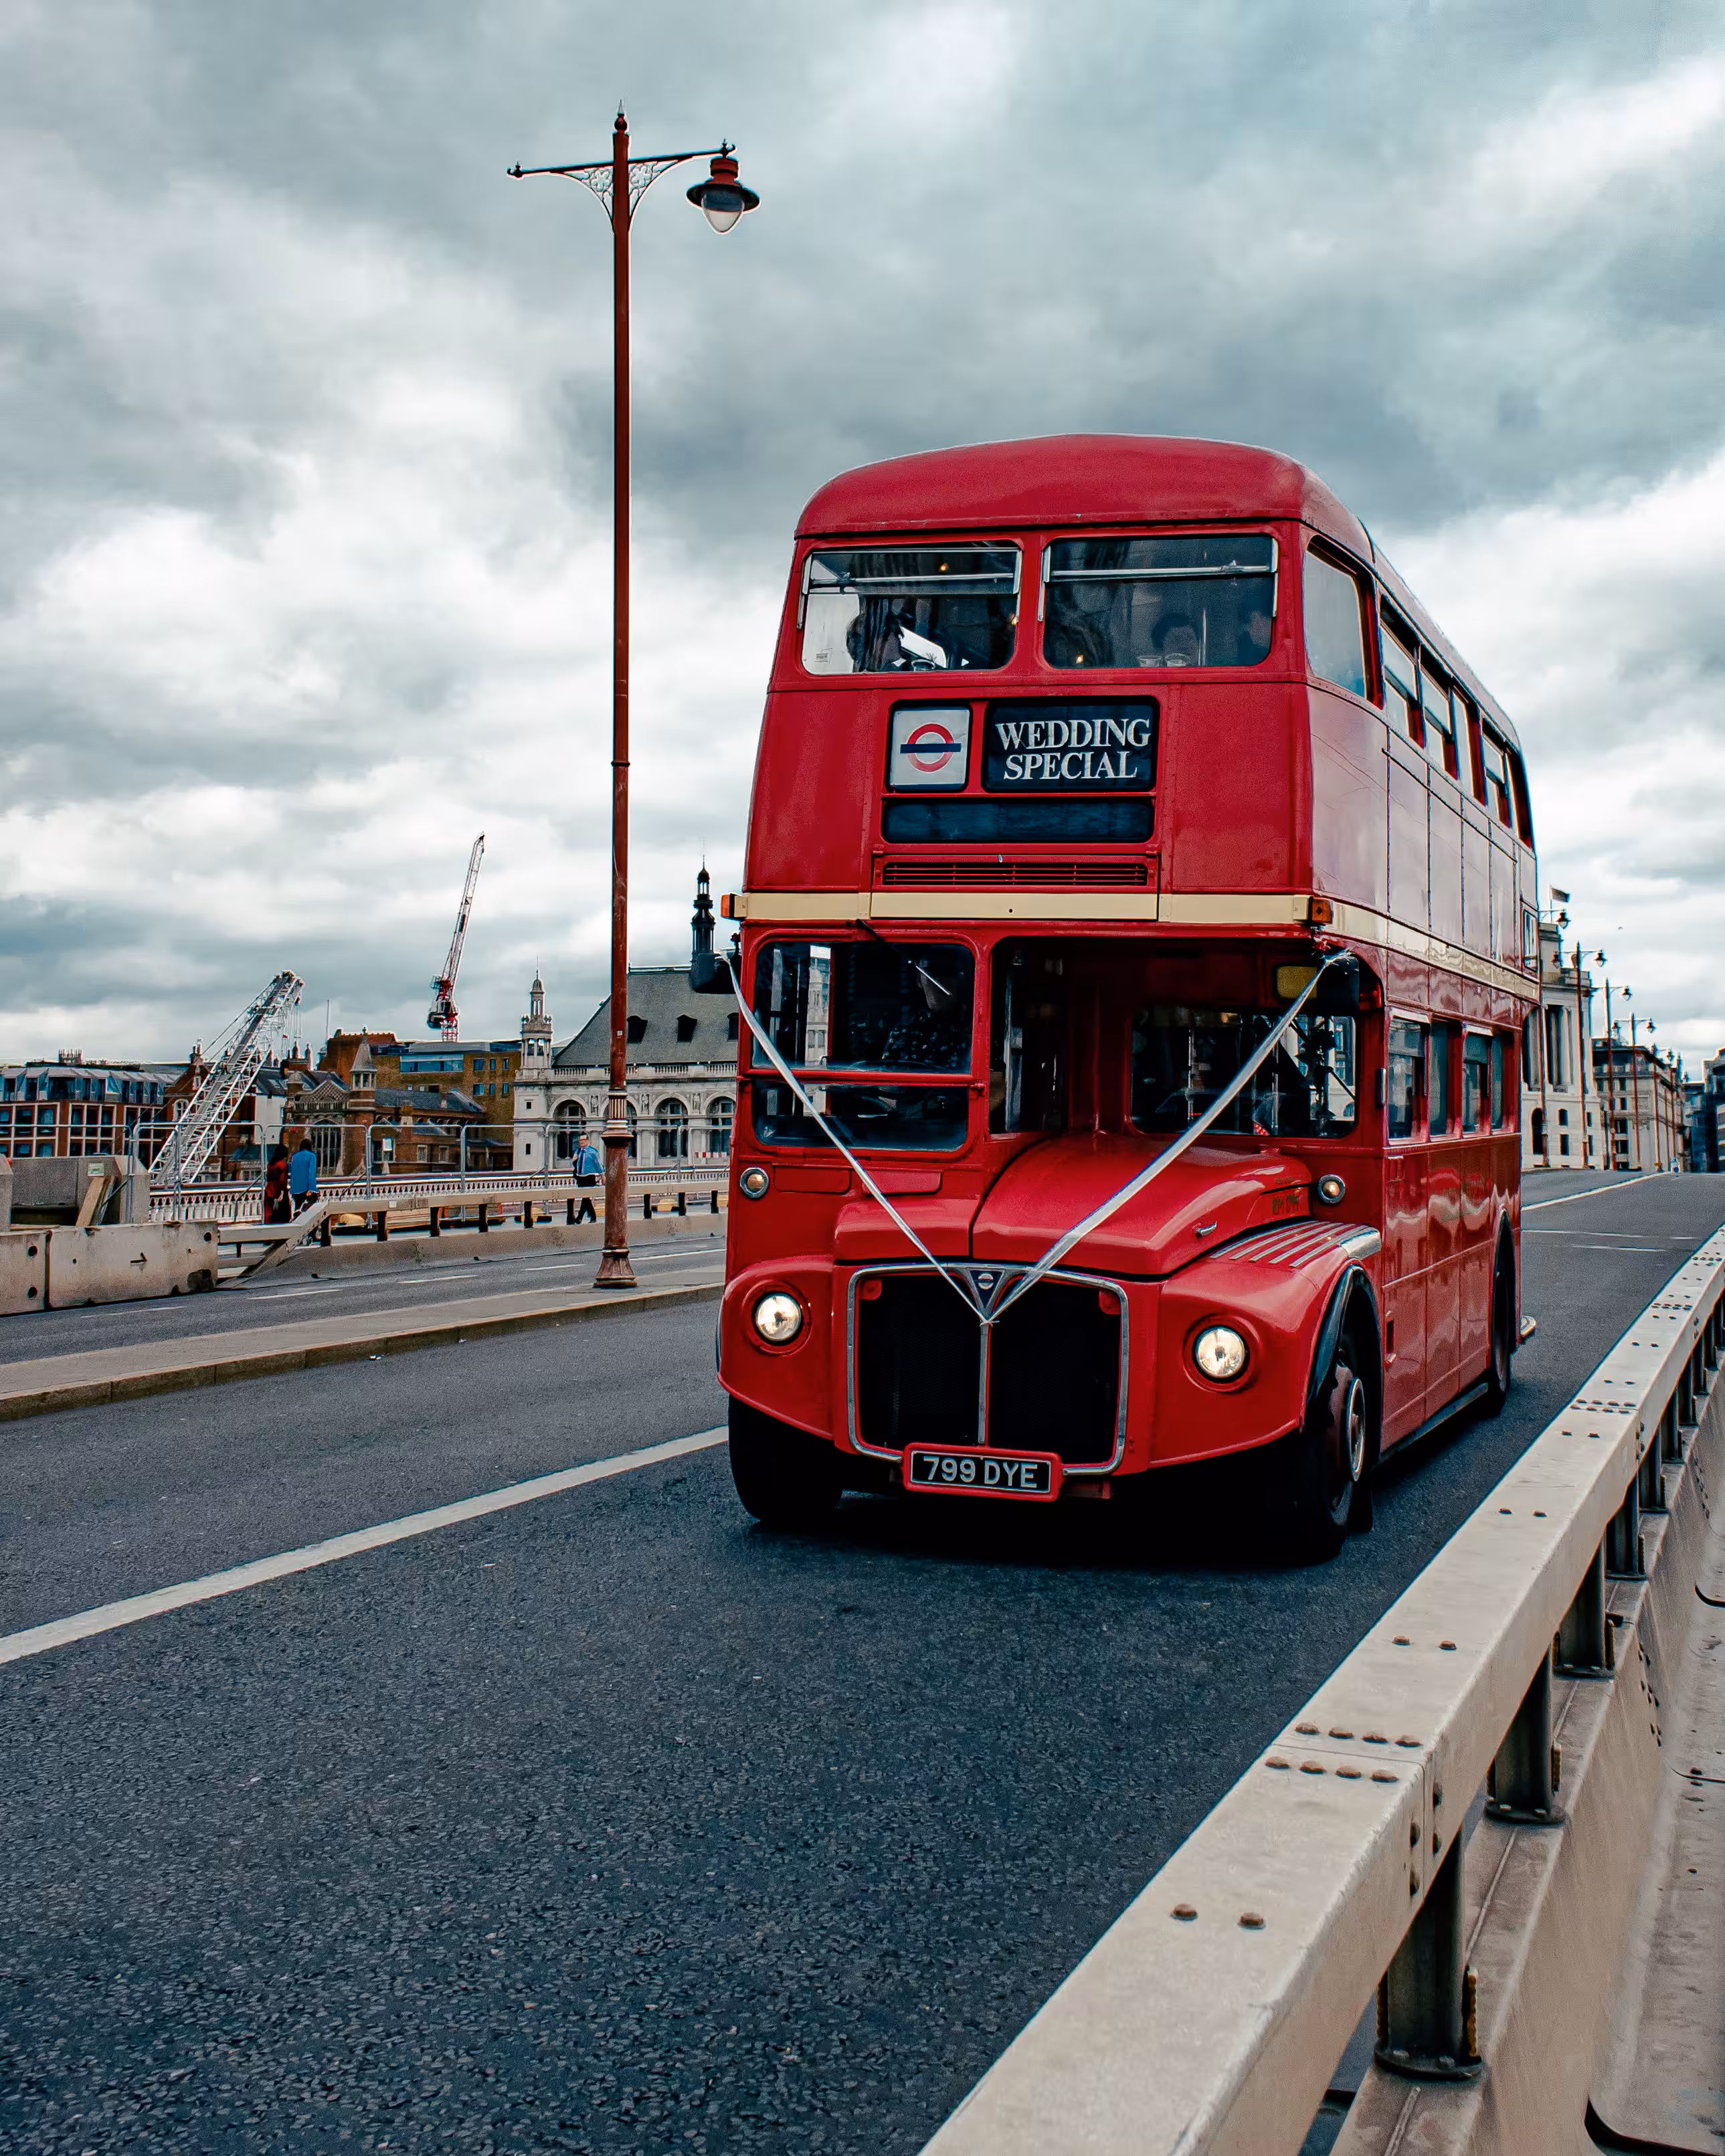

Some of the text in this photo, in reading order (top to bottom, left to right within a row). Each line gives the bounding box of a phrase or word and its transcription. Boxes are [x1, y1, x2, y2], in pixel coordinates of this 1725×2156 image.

[995, 719, 1151, 750] WEDDING
[1004, 751, 1138, 780] SPECIAL
[923, 1456, 1038, 1488] 799 DYE
